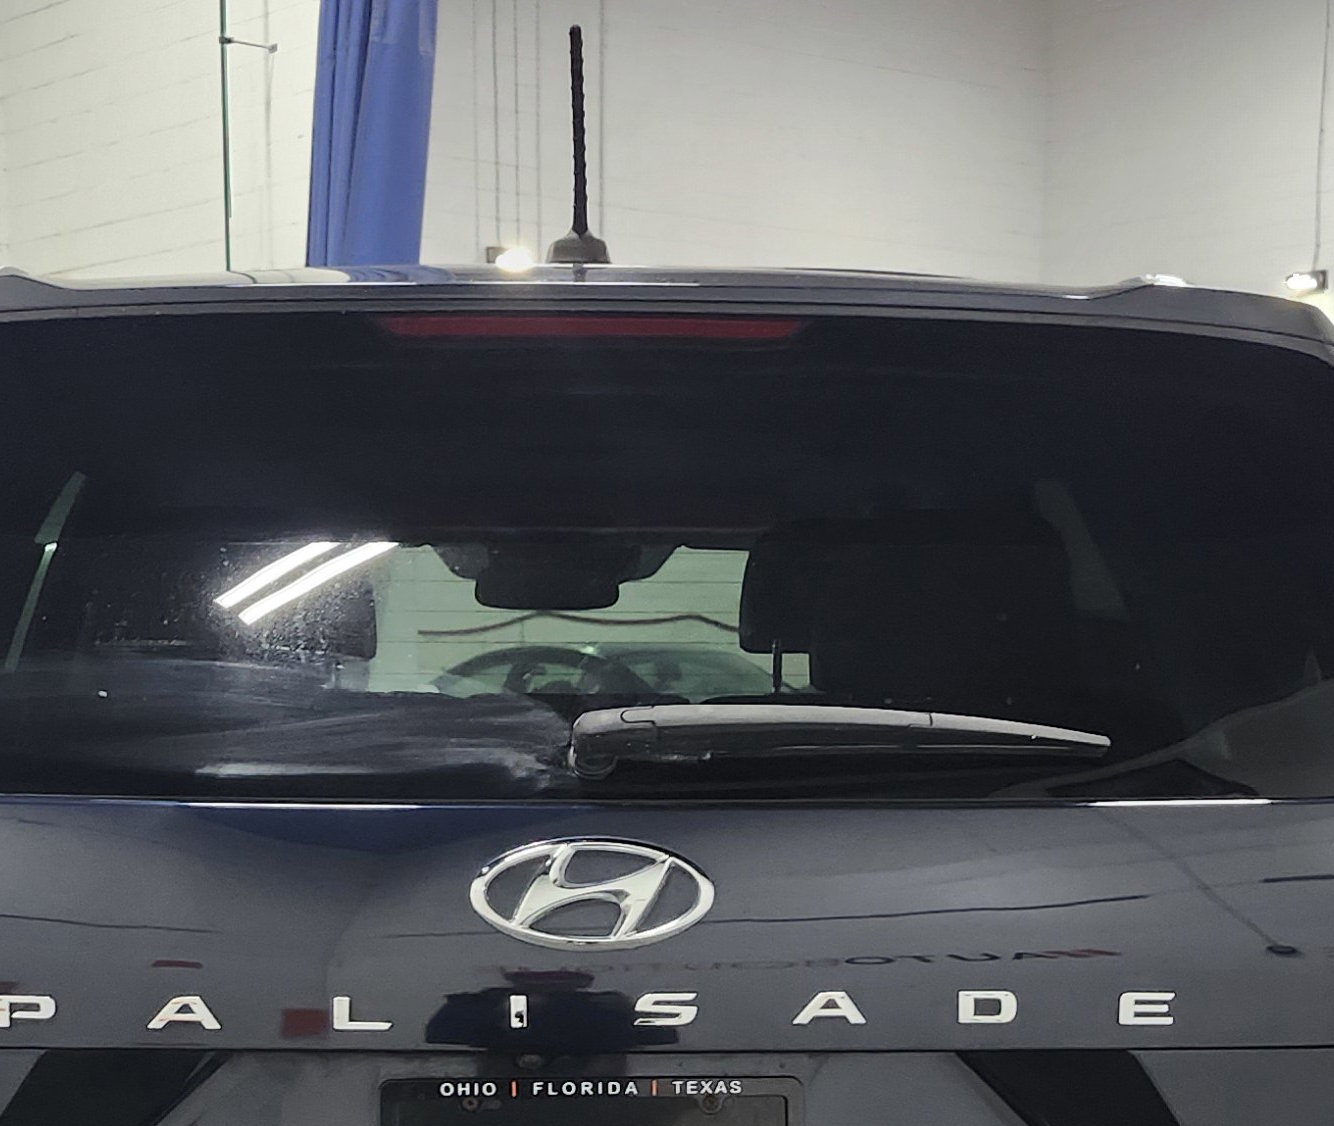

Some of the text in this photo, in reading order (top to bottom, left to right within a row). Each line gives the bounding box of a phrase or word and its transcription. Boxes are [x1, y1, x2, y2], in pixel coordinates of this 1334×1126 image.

[439, 1079, 743, 1097] OHIO FLORIDA TEXAS
